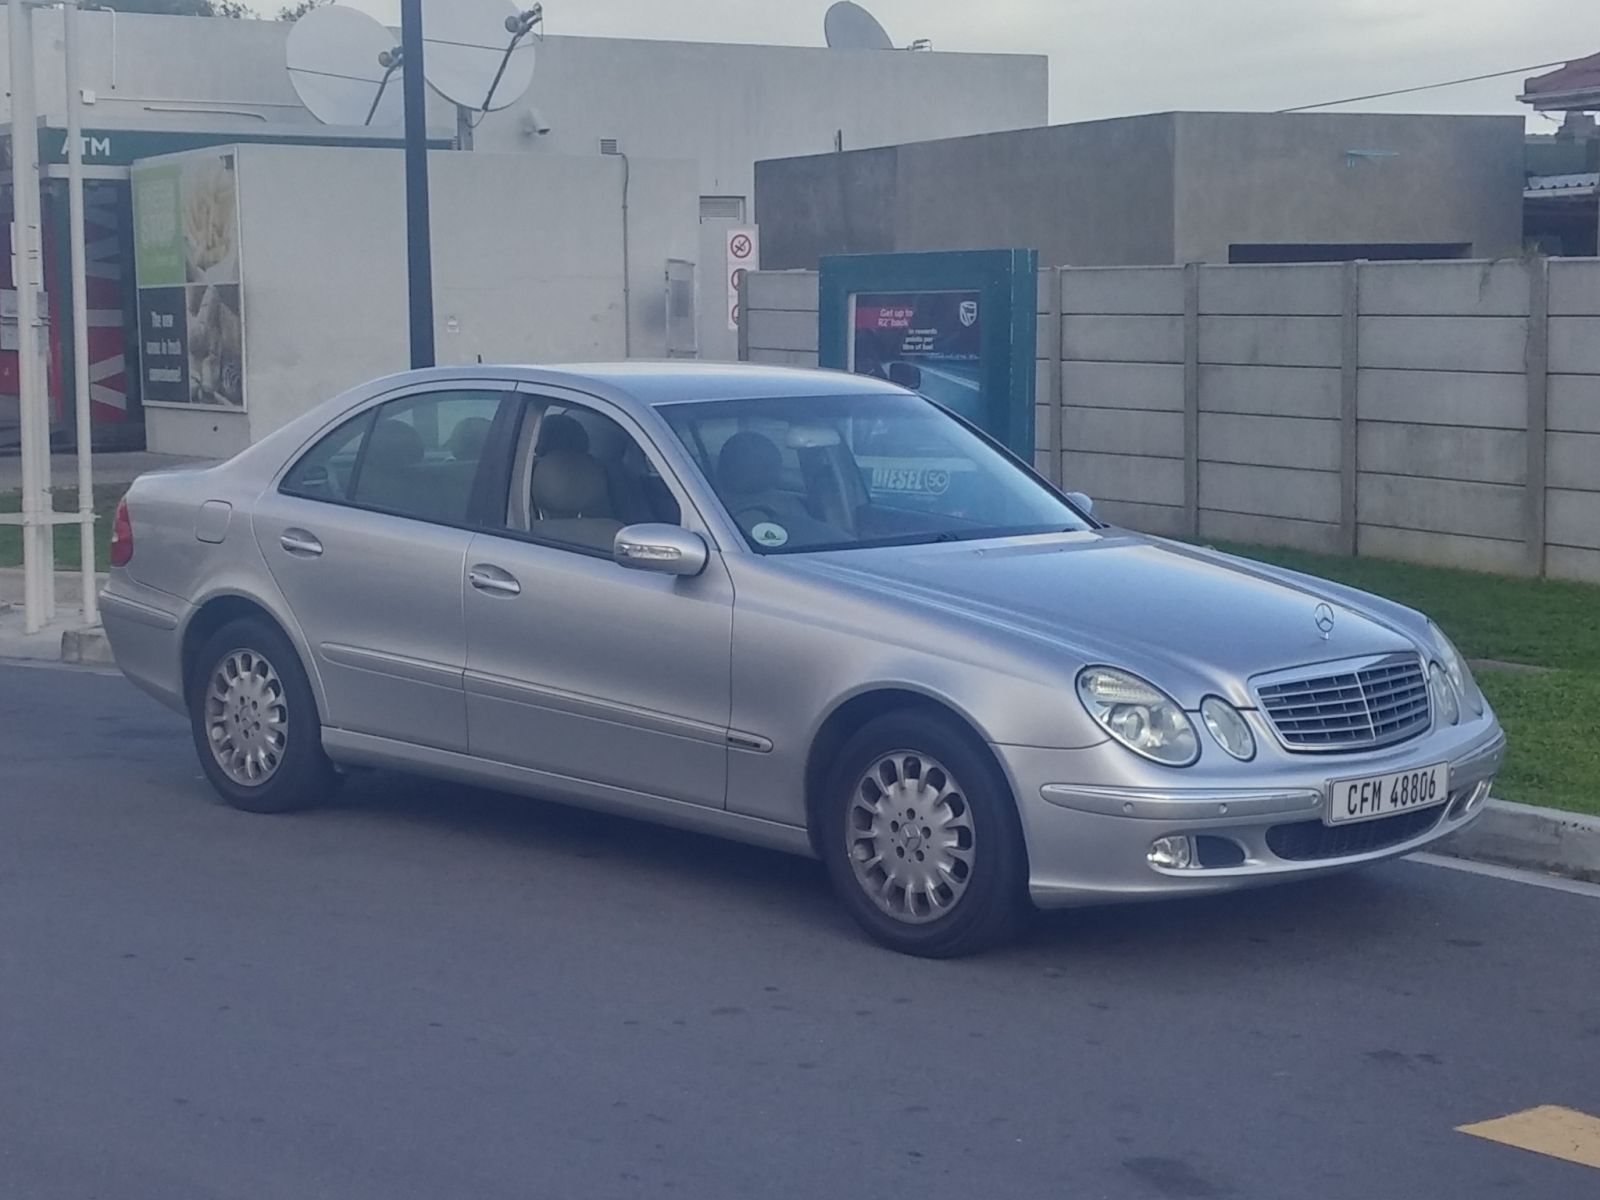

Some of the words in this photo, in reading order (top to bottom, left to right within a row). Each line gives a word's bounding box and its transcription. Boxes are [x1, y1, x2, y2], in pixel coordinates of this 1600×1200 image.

[880, 308, 893, 317] Get
[894, 310, 904, 318] up
[905, 309, 913, 317] to
[891, 318, 909, 327] back
[872, 469, 922, 490] DIESEL
[928, 471, 947, 488] 50
[1347, 781, 1382, 815] CFM
[1390, 769, 1436, 808] 48806
